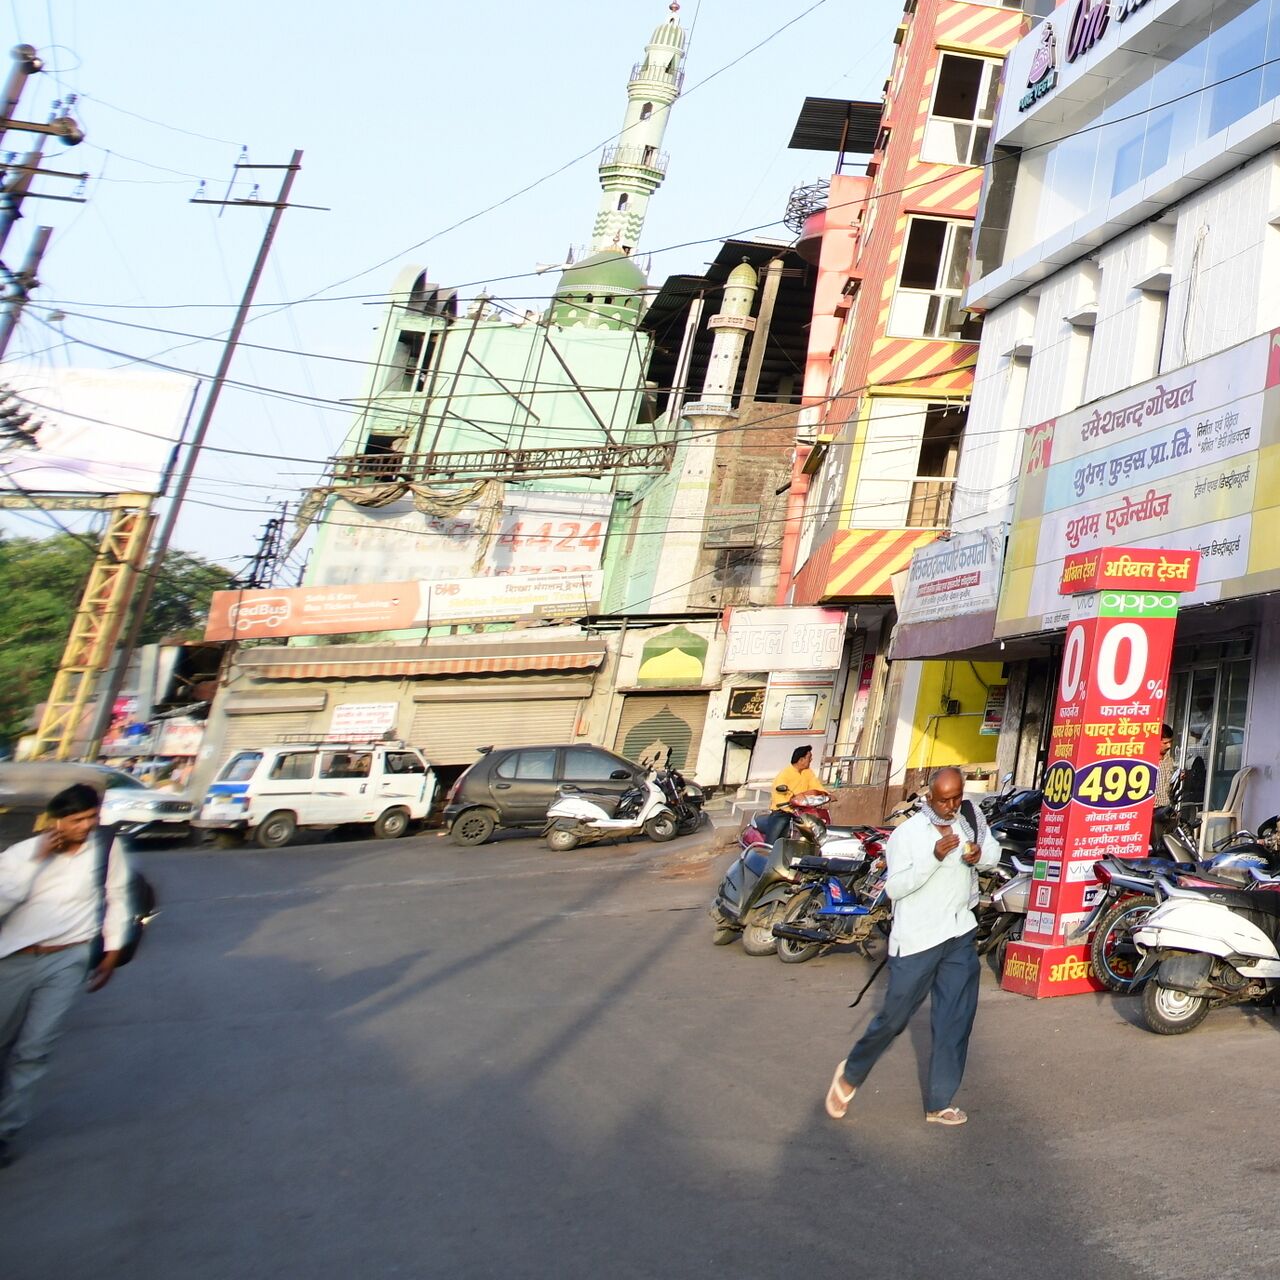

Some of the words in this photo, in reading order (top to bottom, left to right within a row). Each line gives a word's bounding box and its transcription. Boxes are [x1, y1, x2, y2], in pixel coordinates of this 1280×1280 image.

[1145, 380, 1197, 417] गोयल
[1104, 555, 1155, 577] अखिल
[1157, 556, 1191, 582] ट्रेडर्स
[231, 604, 289, 617] redBus
[1077, 596, 1094, 610] vivo
[1103, 594, 1177, 613] oppo
[1085, 723, 1116, 736] पावर
[1118, 718, 1140, 735] बैंक
[1143, 720, 1160, 737] एवं
[1096, 737, 1145, 757] मोबाईल
[1045, 768, 1072, 803] 499
[1078, 765, 1150, 802] 499
